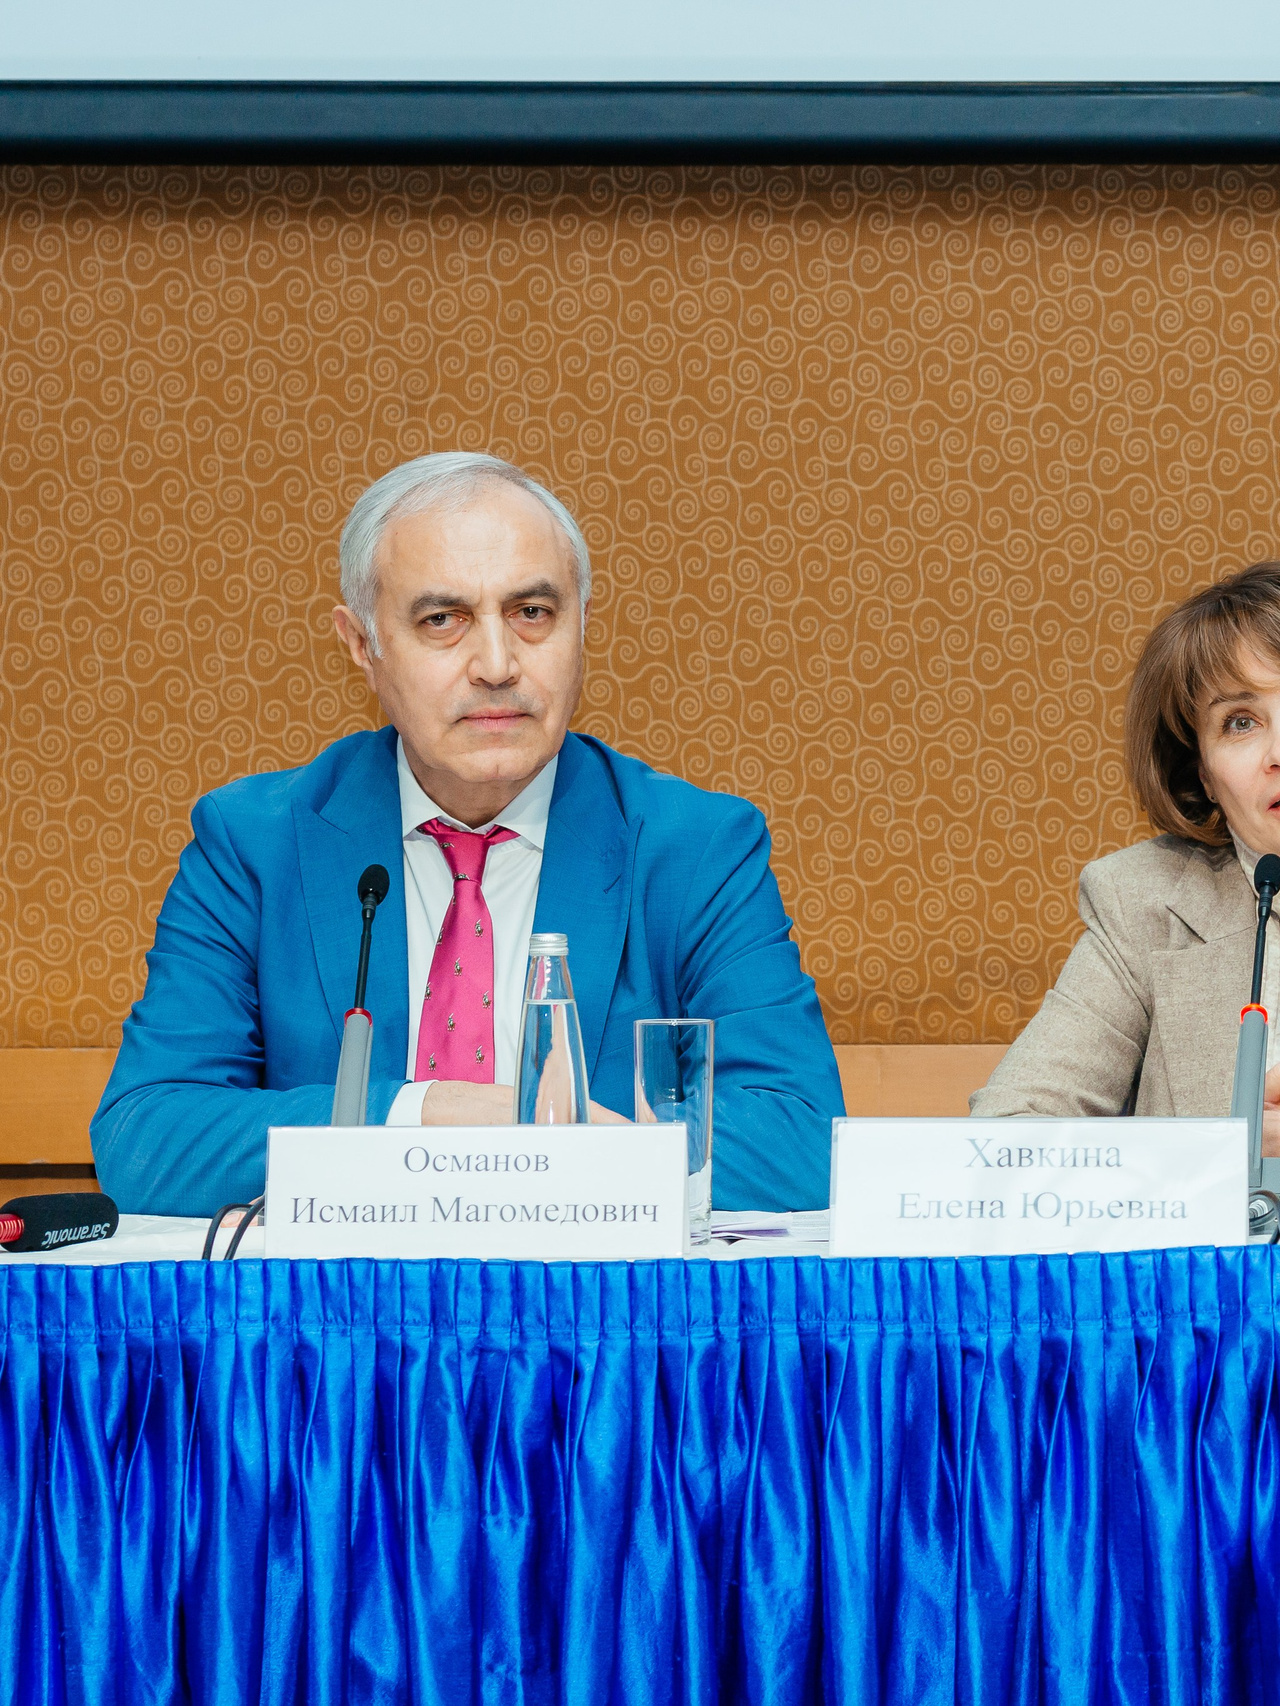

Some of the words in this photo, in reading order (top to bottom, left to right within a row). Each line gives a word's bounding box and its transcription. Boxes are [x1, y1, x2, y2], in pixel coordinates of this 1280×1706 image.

[403, 1146, 550, 1173] Османов
[964, 1138, 1123, 1168] Хавкина
[290, 1197, 417, 1223] Исмаил
[430, 1196, 659, 1226] Магомедович
[897, 1193, 1007, 1219] Елена
[1021, 1192, 1188, 1227] Юрьевна
[41, 1222, 111, 1249] Saramonic
